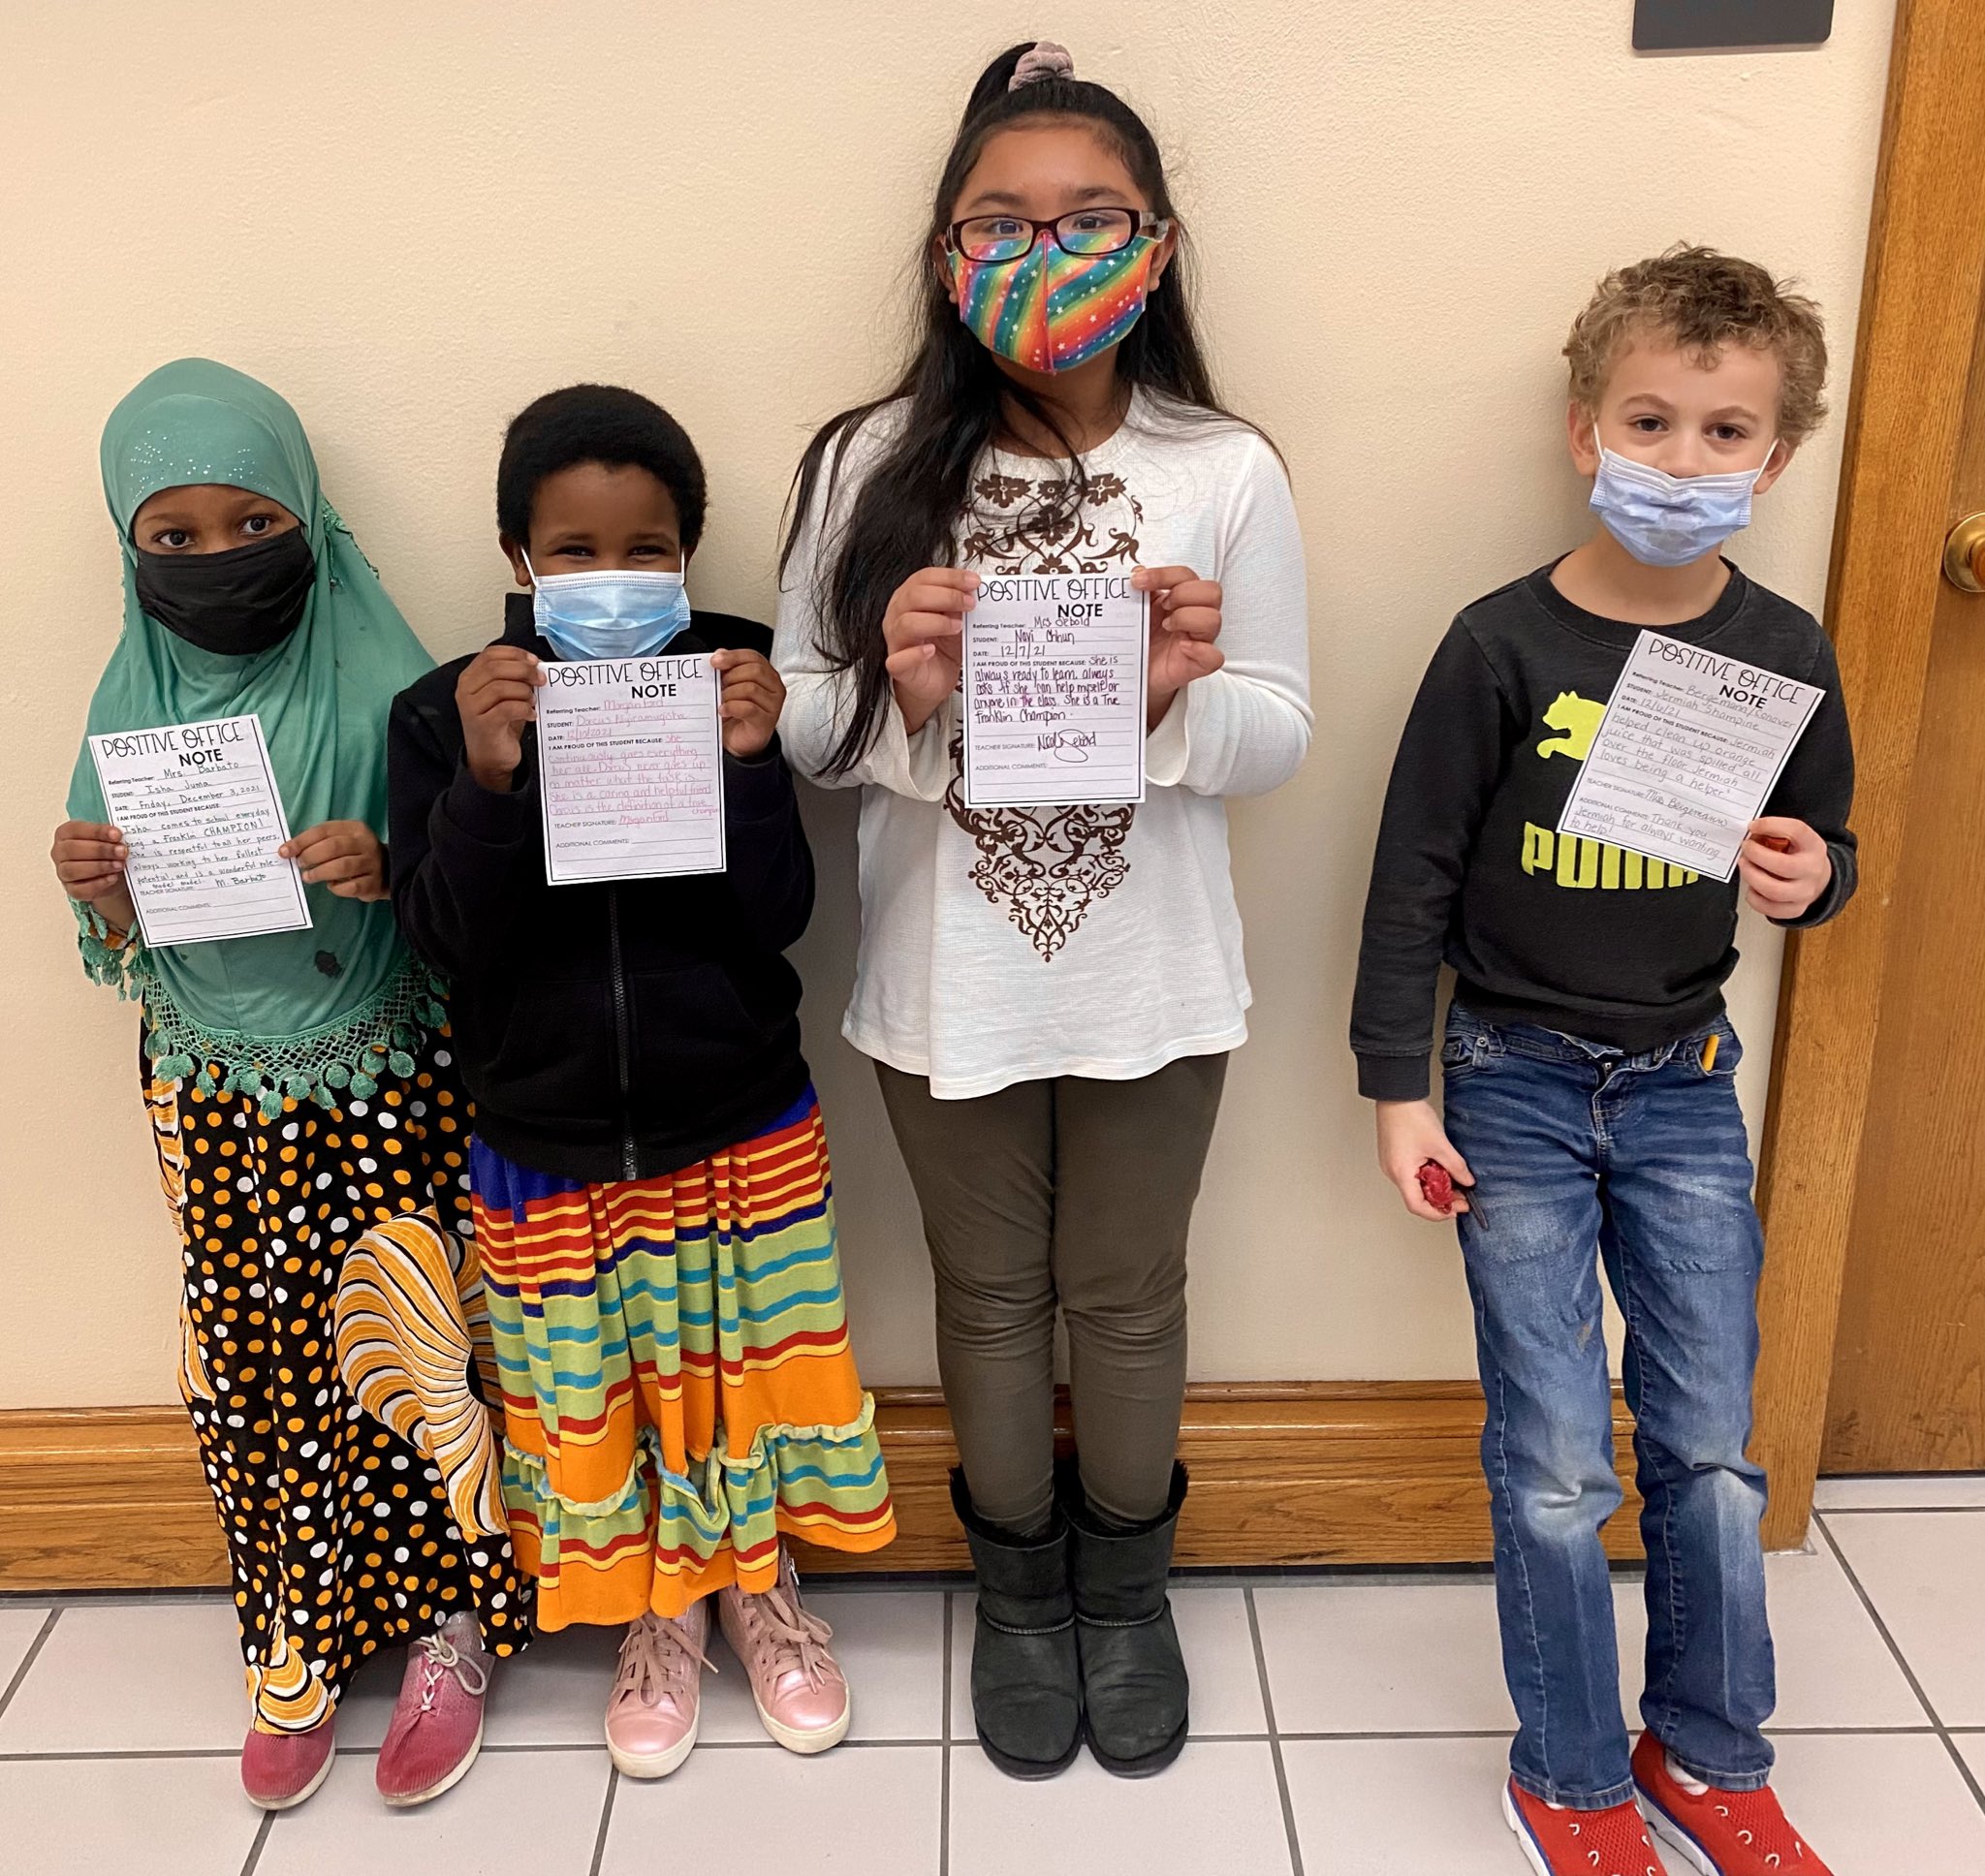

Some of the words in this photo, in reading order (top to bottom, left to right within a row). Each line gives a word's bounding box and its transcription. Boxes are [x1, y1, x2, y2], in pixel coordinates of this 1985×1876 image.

[977, 578, 1059, 602] POSITIVE
[1067, 578, 1130, 600] OFFICE
[1057, 604, 1103, 617] NOTE
[548, 663, 633, 687] POSITIVE
[640, 658, 702, 681] OFFICE
[975, 671, 1008, 682] always
[1012, 670, 1038, 691] ready
[1041, 669, 1050, 679] to
[1083, 668, 1114, 689] always
[1649, 639, 1735, 680] POSITIVE
[1738, 670, 1805, 704] OFFICE
[632, 683, 677, 699] NOTE
[976, 682, 992, 695] asks
[1013, 683, 1028, 695] she
[1036, 683, 1052, 694] can
[1056, 680, 1076, 696] help
[1108, 683, 1119, 692] or
[1719, 685, 1767, 708] NOTE
[974, 698, 1005, 714] anyone
[1006, 697, 1017, 707] in
[1020, 696, 1033, 707] the
[1064, 694, 1080, 706] She
[1083, 694, 1090, 705] is
[1101, 694, 1120, 705] True
[975, 710, 1013, 724] Franklin
[1632, 708, 1653, 719] PROUD
[1675, 723, 1700, 734] STUDENT
[102, 731, 178, 758] POSITIVE
[182, 722, 243, 748] OFFICE
[1602, 738, 1627, 752] over
[1636, 747, 1654, 761] the
[1611, 712, 1650, 732] helped
[1654, 727, 1686, 743] clean
[1691, 739, 1711, 753] up
[1715, 747, 1755, 769] orange
[178, 749, 223, 766] NOTE
[1601, 724, 1634, 742] juice
[1641, 735, 1663, 749] that
[1669, 746, 1692, 759] was
[1698, 755, 1737, 773] spilled
[1742, 767, 1761, 780] all
[197, 762, 239, 774] Barbato
[1600, 749, 1628, 766] loves
[1633, 761, 1668, 782] being
[1675, 773, 1684, 783] a
[145, 785, 174, 795] Isha
[184, 780, 211, 790] Juma
[179, 792, 224, 804] December
[122, 825, 151, 834] Isha
[161, 820, 190, 829] comes
[205, 813, 230, 824] school
[236, 808, 269, 820] everyday
[205, 818, 264, 837] CHAMPION!
[1569, 816, 1581, 829] to
[1651, 813, 1684, 830] Thank
[1686, 827, 1708, 840] you
[1623, 815, 1636, 828] for
[1640, 824, 1675, 841] always
[1678, 837, 1719, 860] wanting
[134, 863, 160, 872] always
[167, 859, 197, 868] working
[236, 848, 265, 859] fullest
[169, 843, 208, 856] respectful
[1522, 822, 1698, 890] PUM
[218, 861, 256, 874] wonderful
[232, 874, 267, 885] Barbato
